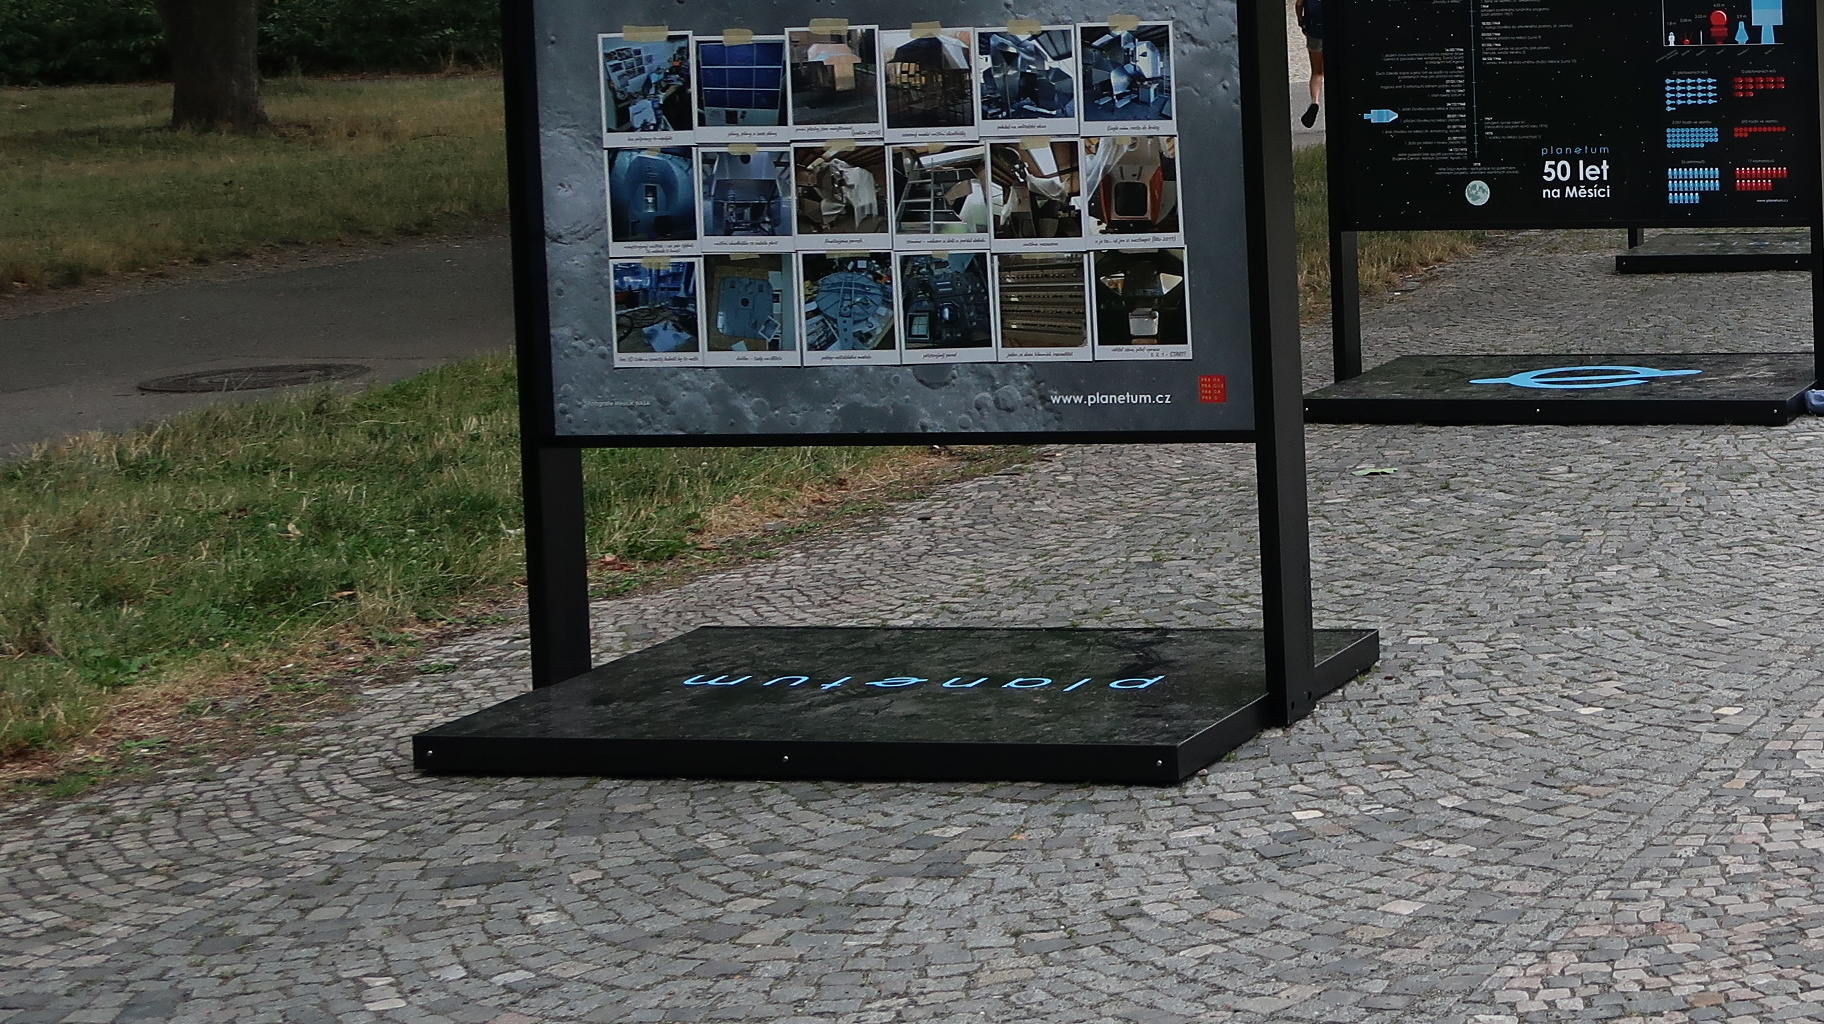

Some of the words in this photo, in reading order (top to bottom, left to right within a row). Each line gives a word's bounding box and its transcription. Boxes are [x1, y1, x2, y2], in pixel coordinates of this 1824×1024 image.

[1541, 145, 1609, 156] planetum
[1542, 160, 1571, 182] 50
[1579, 159, 1610, 181] let
[1542, 189, 1560, 198] na
[1565, 183, 1610, 198] Měsíci
[1050, 391, 1172, 407] www.planetum.cz
[683, 674, 1166, 692] planetum
